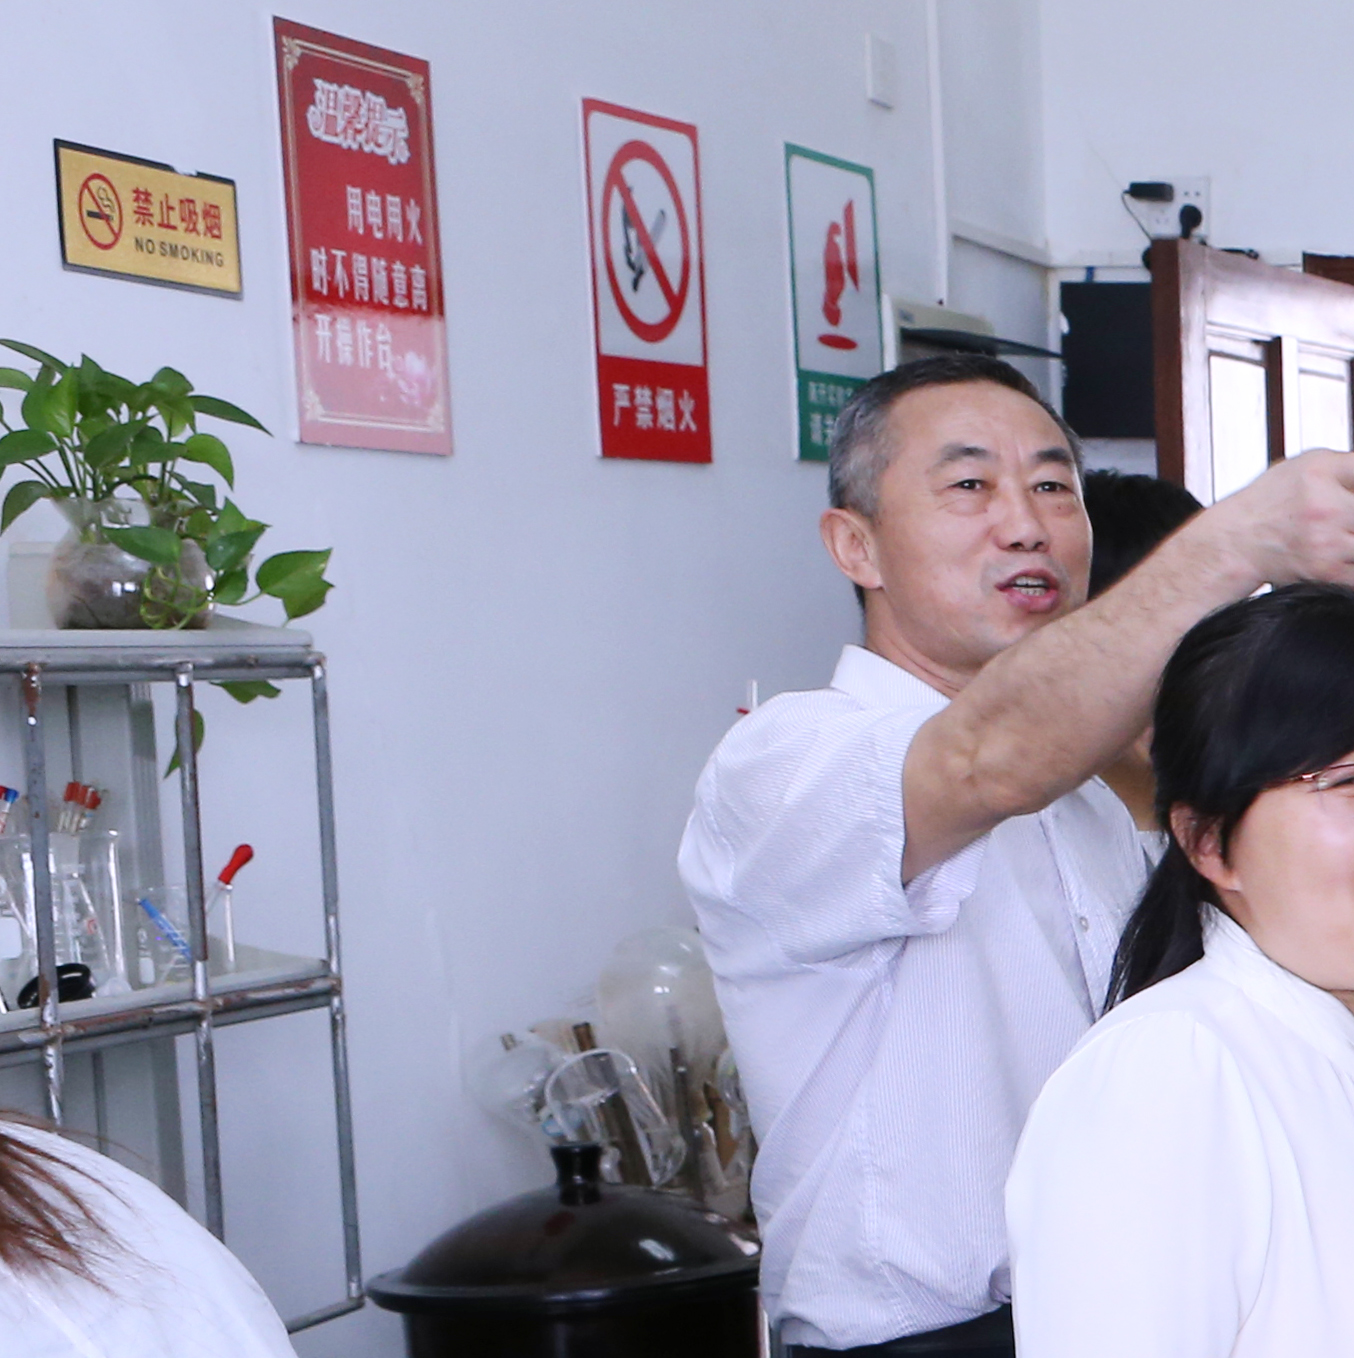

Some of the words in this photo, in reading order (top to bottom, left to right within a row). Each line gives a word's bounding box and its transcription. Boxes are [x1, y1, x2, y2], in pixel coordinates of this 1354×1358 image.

[132, 187, 223, 240] 禁止吸烟
[346, 184, 423, 246] 用电用火
[134, 237, 156, 254] NO
[159, 241, 224, 267] SMOKING
[310, 246, 428, 312] 时不得随意离
[612, 383, 697, 432] 严禁烟火
